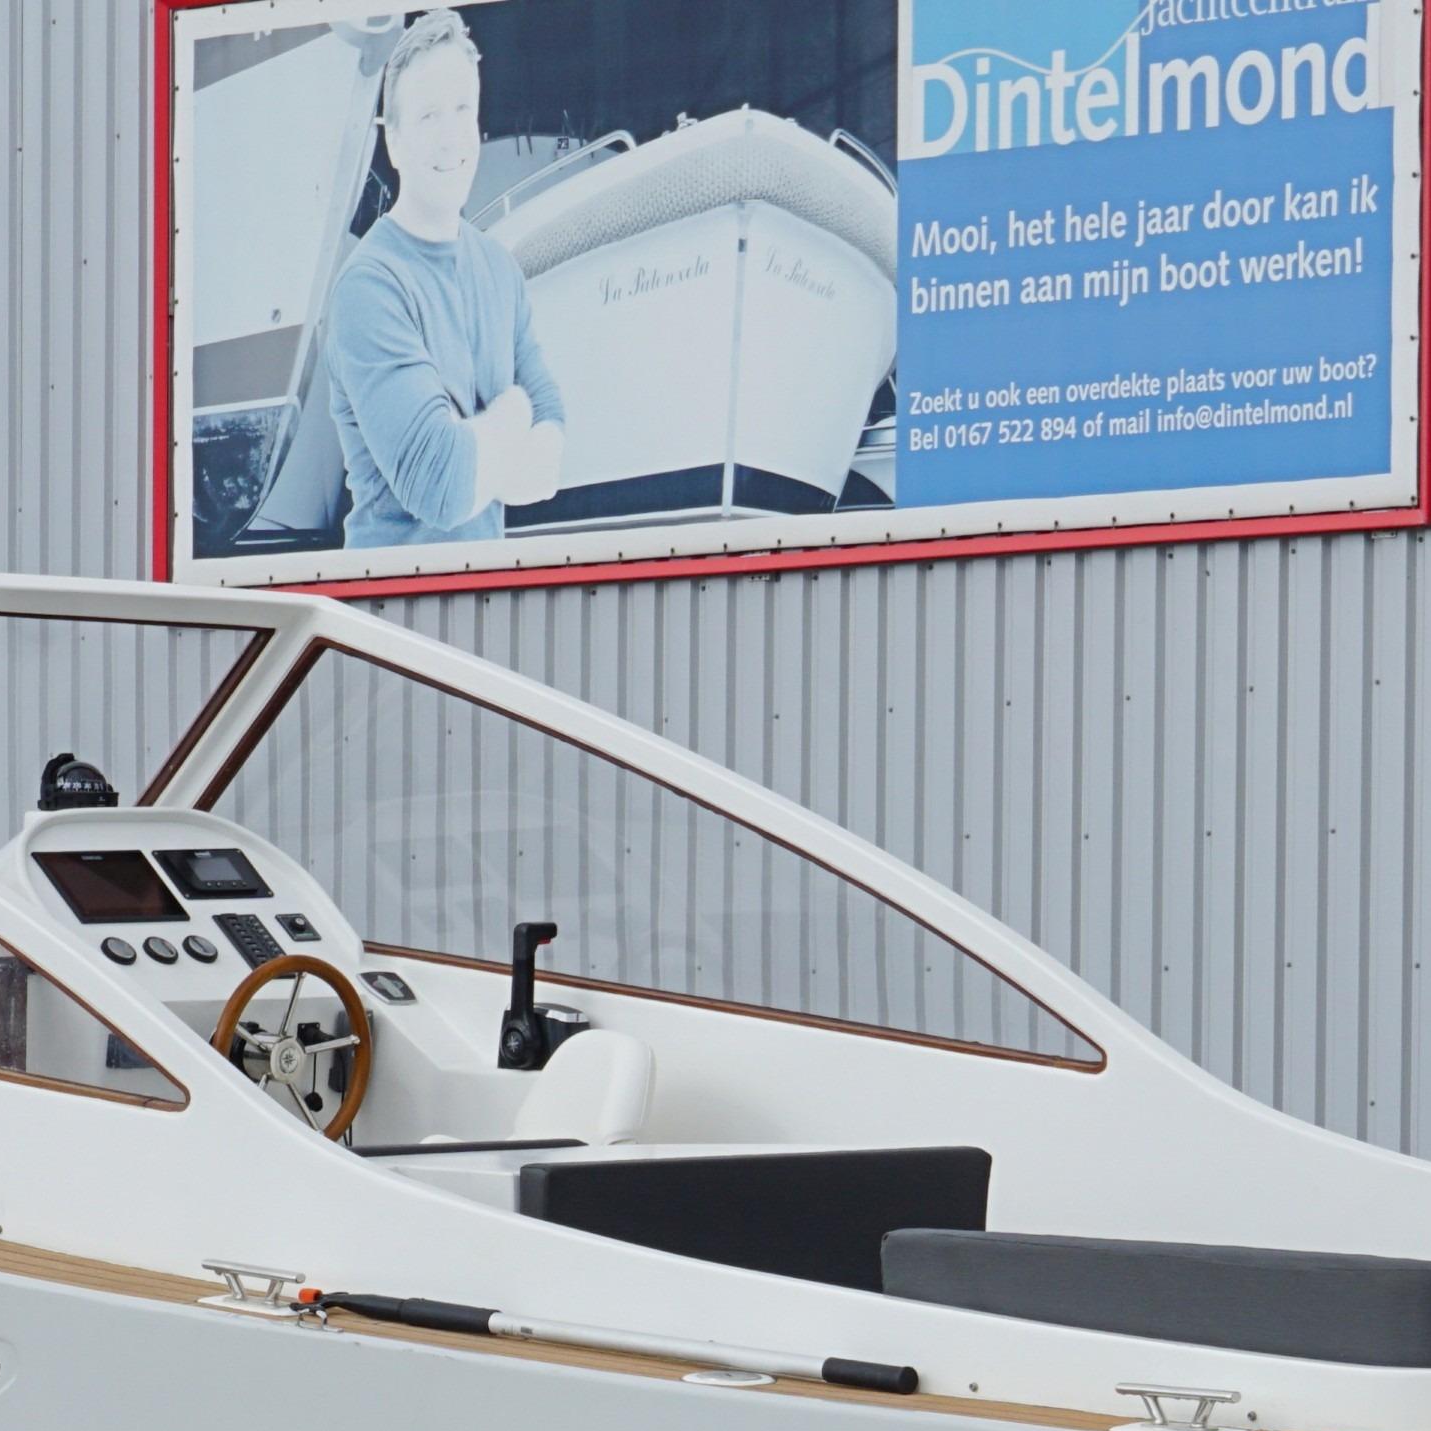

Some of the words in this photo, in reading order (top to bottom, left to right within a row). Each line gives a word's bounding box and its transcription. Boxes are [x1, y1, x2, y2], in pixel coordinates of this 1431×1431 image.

[911, 8, 1380, 159] Dintelmond
[912, 216, 996, 257] Mooi,
[1009, 210, 1055, 247] het
[1065, 202, 1127, 242] hele
[1135, 201, 1193, 247] jaar
[1203, 190, 1274, 229] door
[1285, 183, 1338, 221] kan
[1351, 175, 1378, 214] ik
[912, 277, 1009, 314] binnen
[1021, 274, 1071, 304] aan
[1084, 260, 1148, 306] mijn
[1161, 251, 1230, 291] boot
[1240, 237, 1362, 283] werken!
[910, 388, 962, 415] Zoekt
[968, 392, 979, 409] u
[986, 382, 1020, 407] ook
[1026, 386, 1060, 405] een
[1066, 373, 1161, 402] overdekte
[1167, 368, 1225, 401] plaats
[1231, 368, 1276, 388] voor
[1283, 366, 1312, 385] uw
[1320, 354, 1377, 381] boot?
[910, 425, 938, 451] Bel
[945, 422, 992, 448] 0167
[999, 419, 1033, 443] 522
[1041, 416, 1076, 440] 894
[1083, 412, 1103, 437] of
[1109, 408, 1149, 435] mail
[1158, 392, 1352, 432] info@dintelmond.nl
